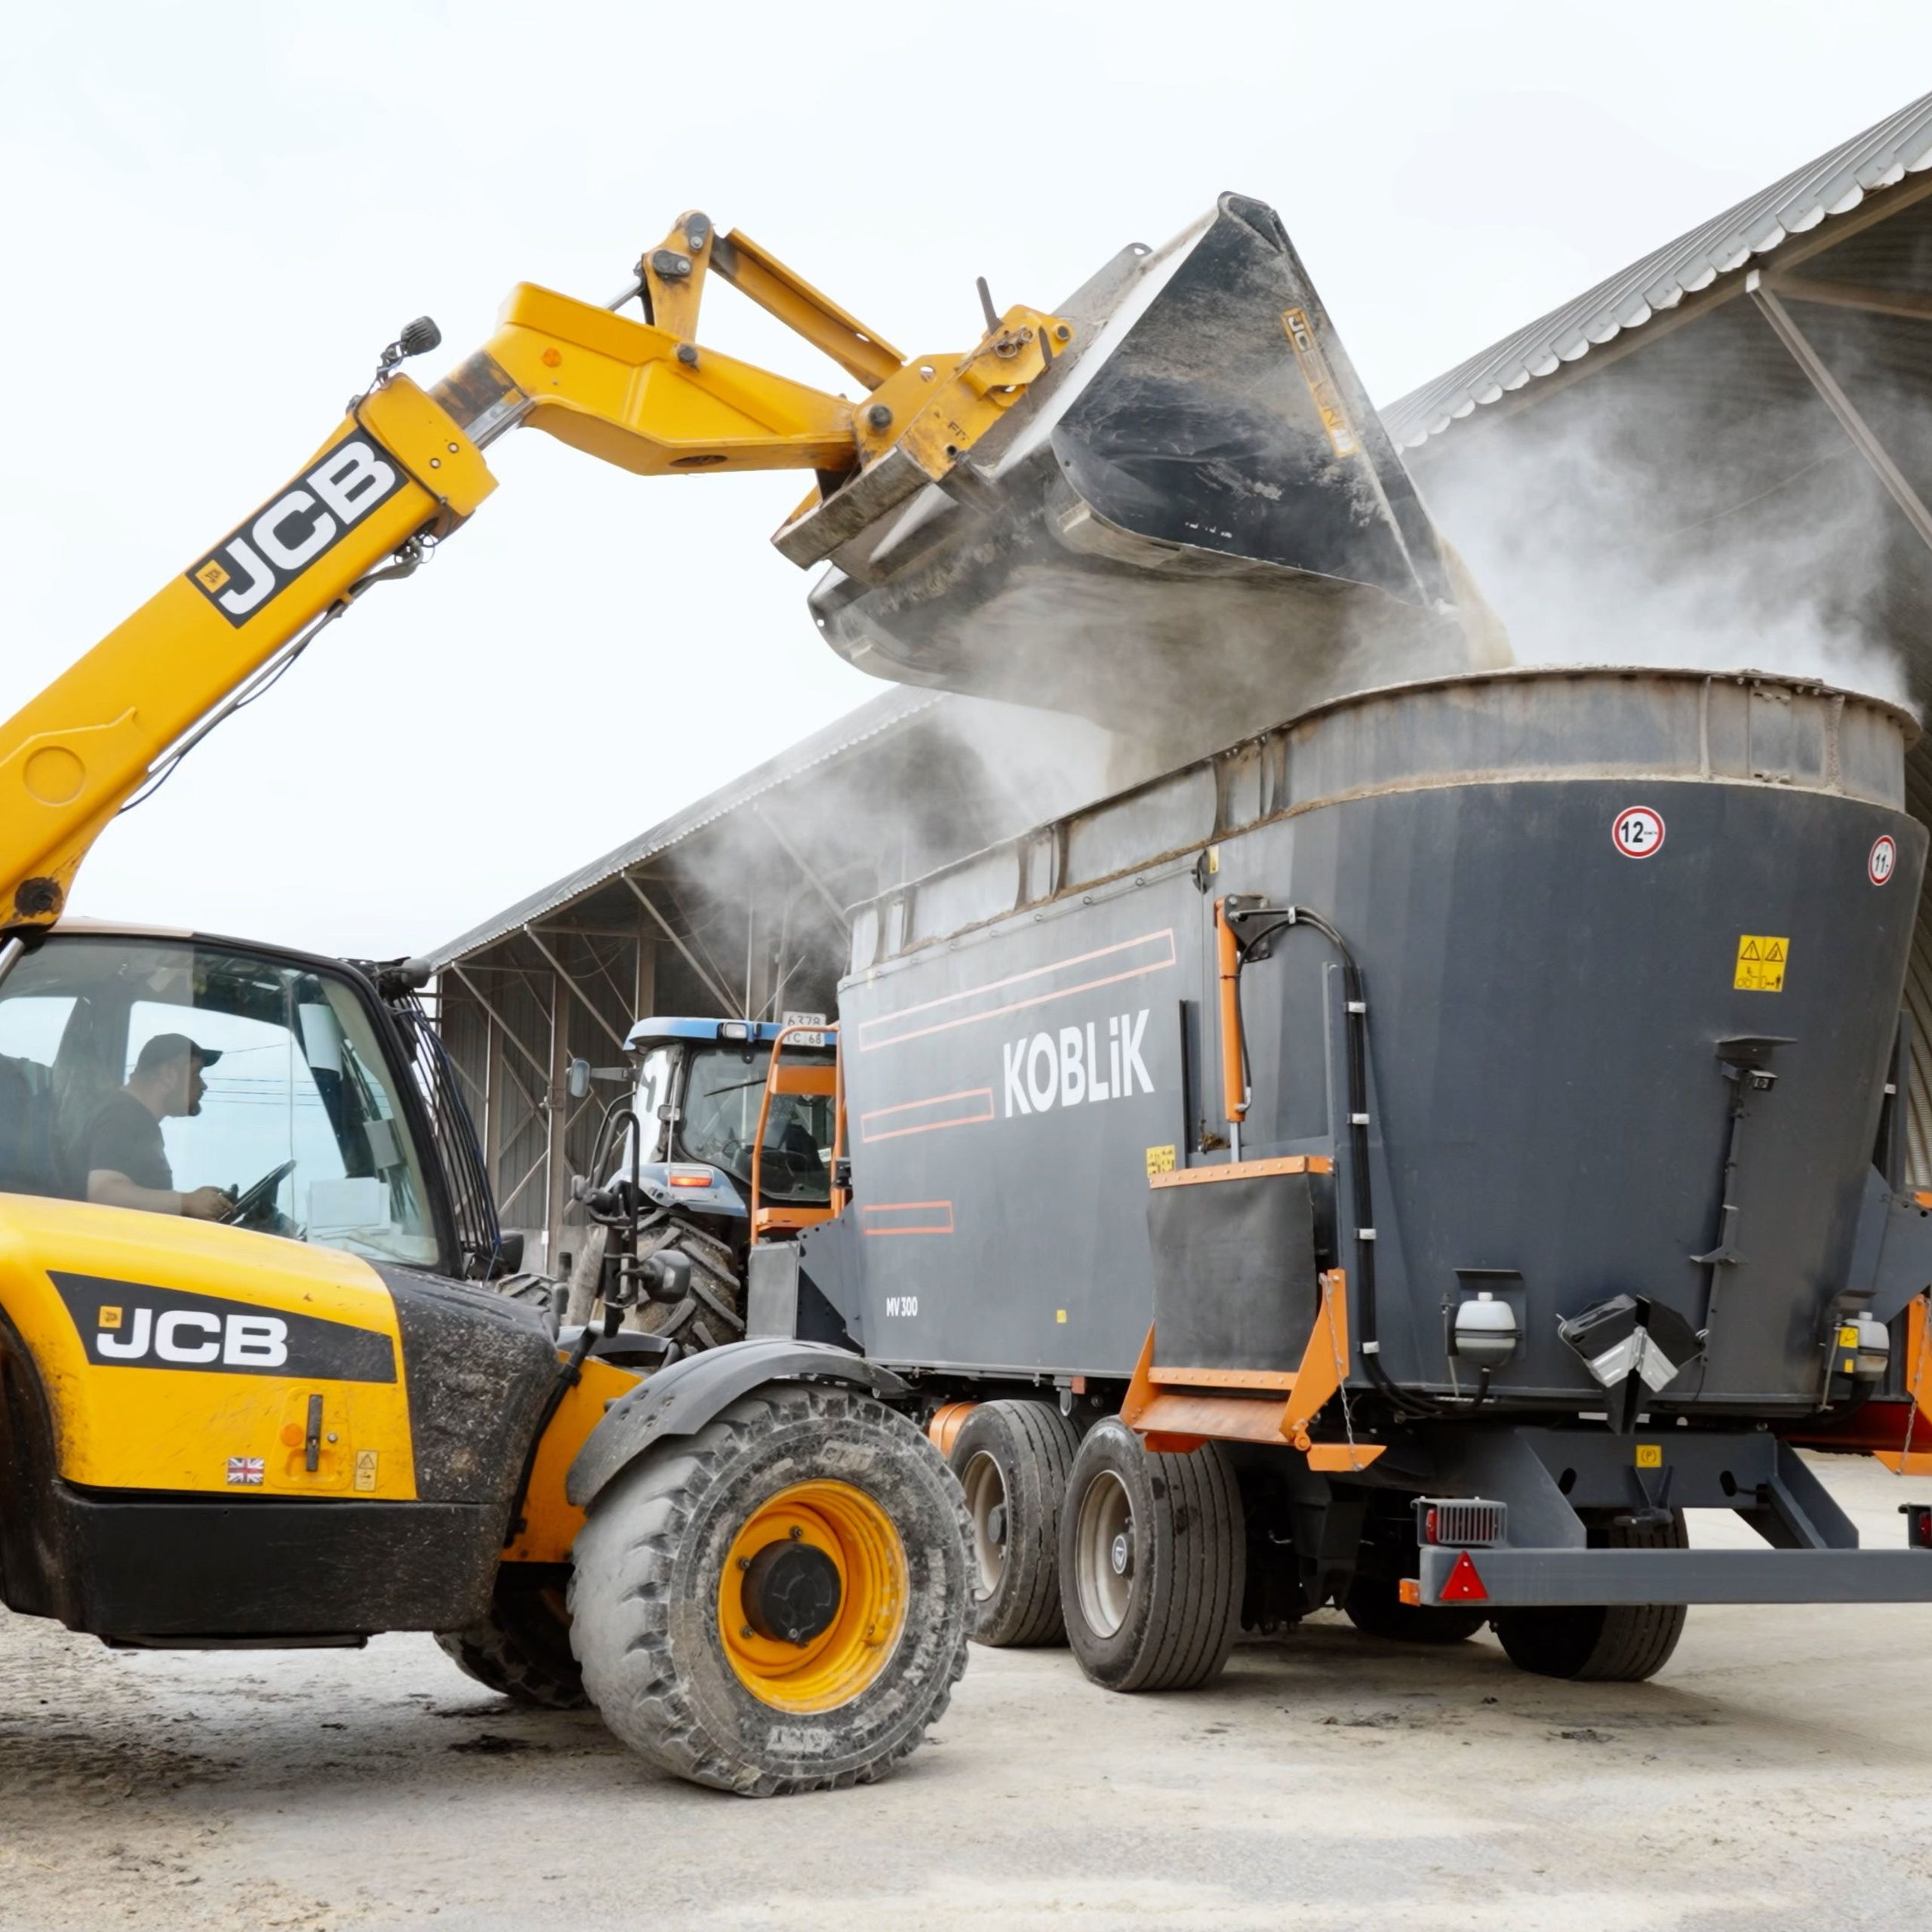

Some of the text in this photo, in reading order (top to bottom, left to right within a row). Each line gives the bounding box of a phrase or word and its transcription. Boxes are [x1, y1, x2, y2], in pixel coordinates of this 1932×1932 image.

[218, 441, 396, 615] JCB
[1620, 820, 1644, 843] 12
[808, 1032, 822, 1044] 68
[886, 1297, 918, 1317] MV 300
[97, 1308, 288, 1367] JCB
